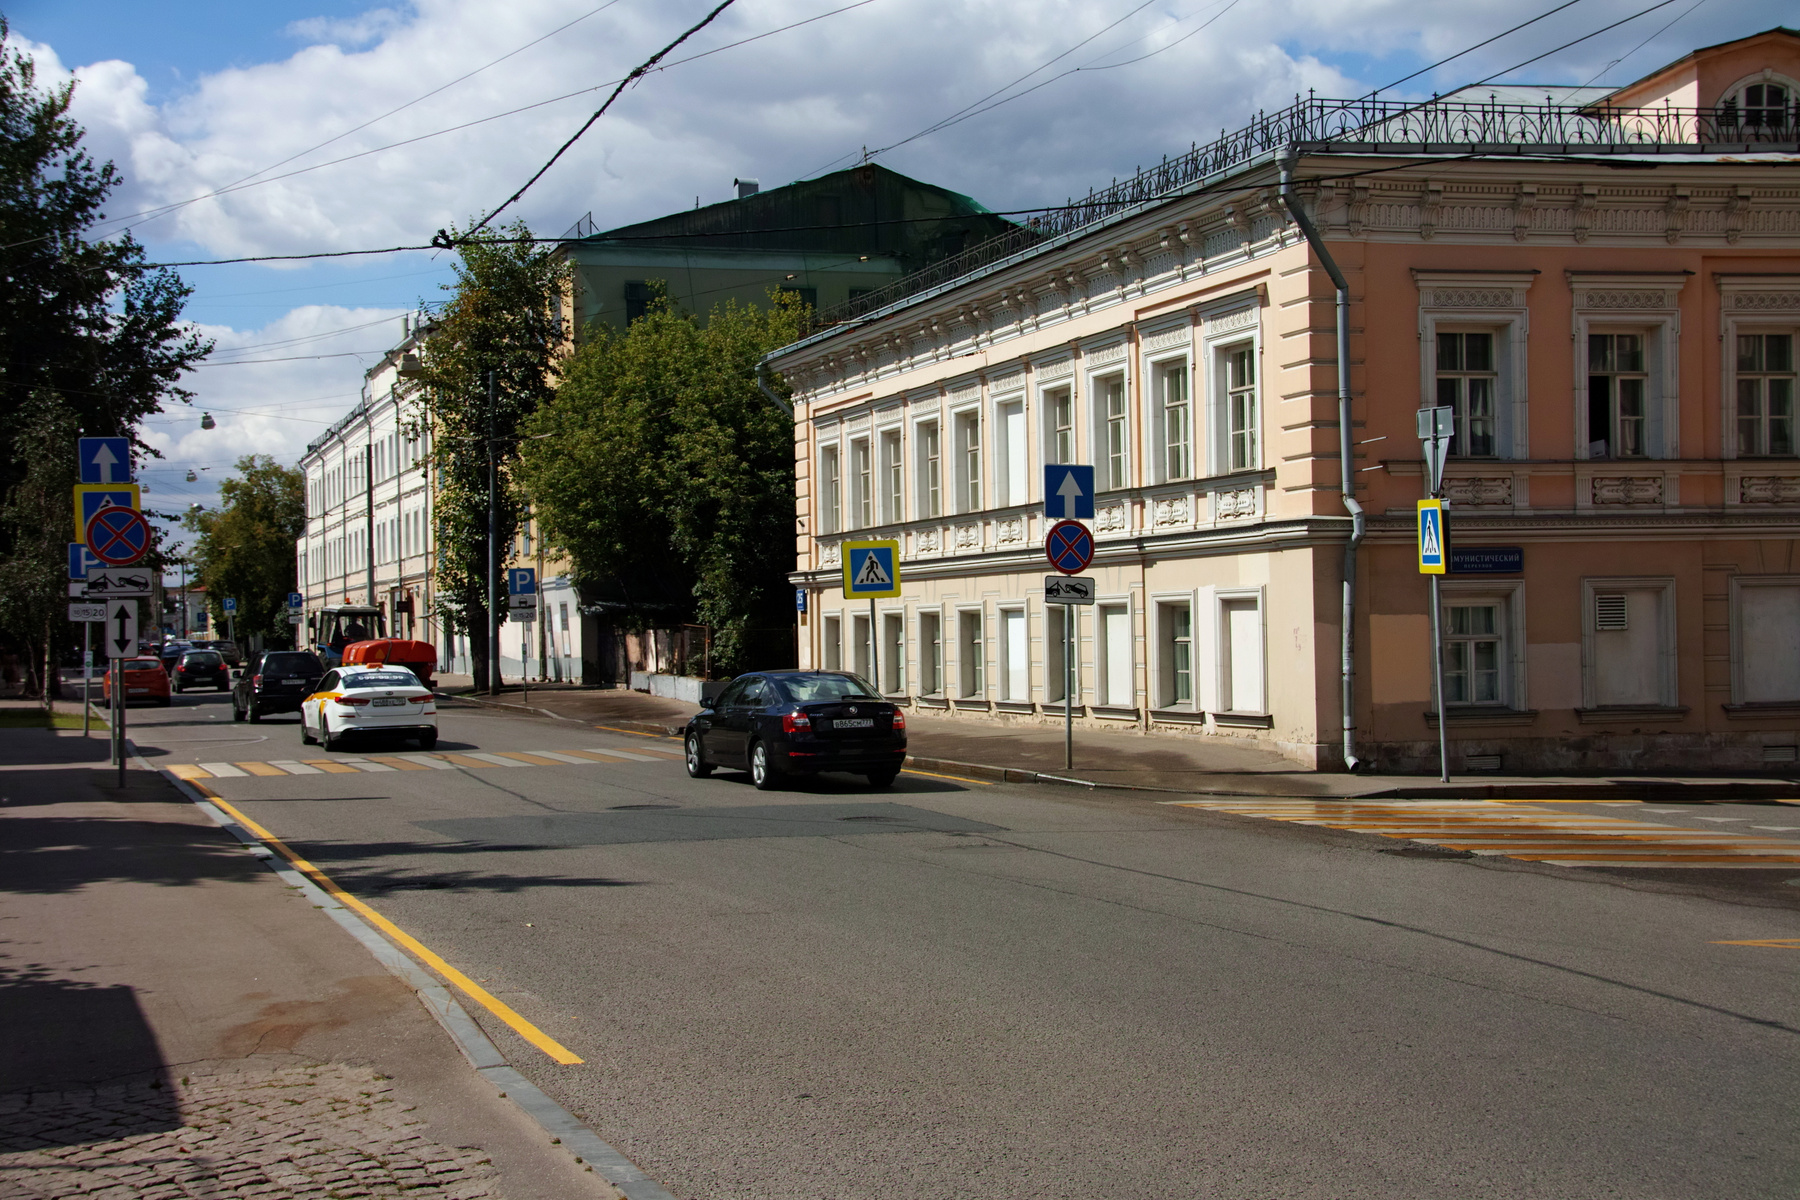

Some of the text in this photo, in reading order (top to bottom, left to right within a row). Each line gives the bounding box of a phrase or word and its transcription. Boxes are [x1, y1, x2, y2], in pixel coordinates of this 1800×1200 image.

[1450, 553, 1520, 563] МУНИСТИЧЕСКИЙ
[515, 571, 531, 592] P
[226, 599, 234, 608] P
[292, 594, 300, 606] P
[93, 608, 104, 616] 20
